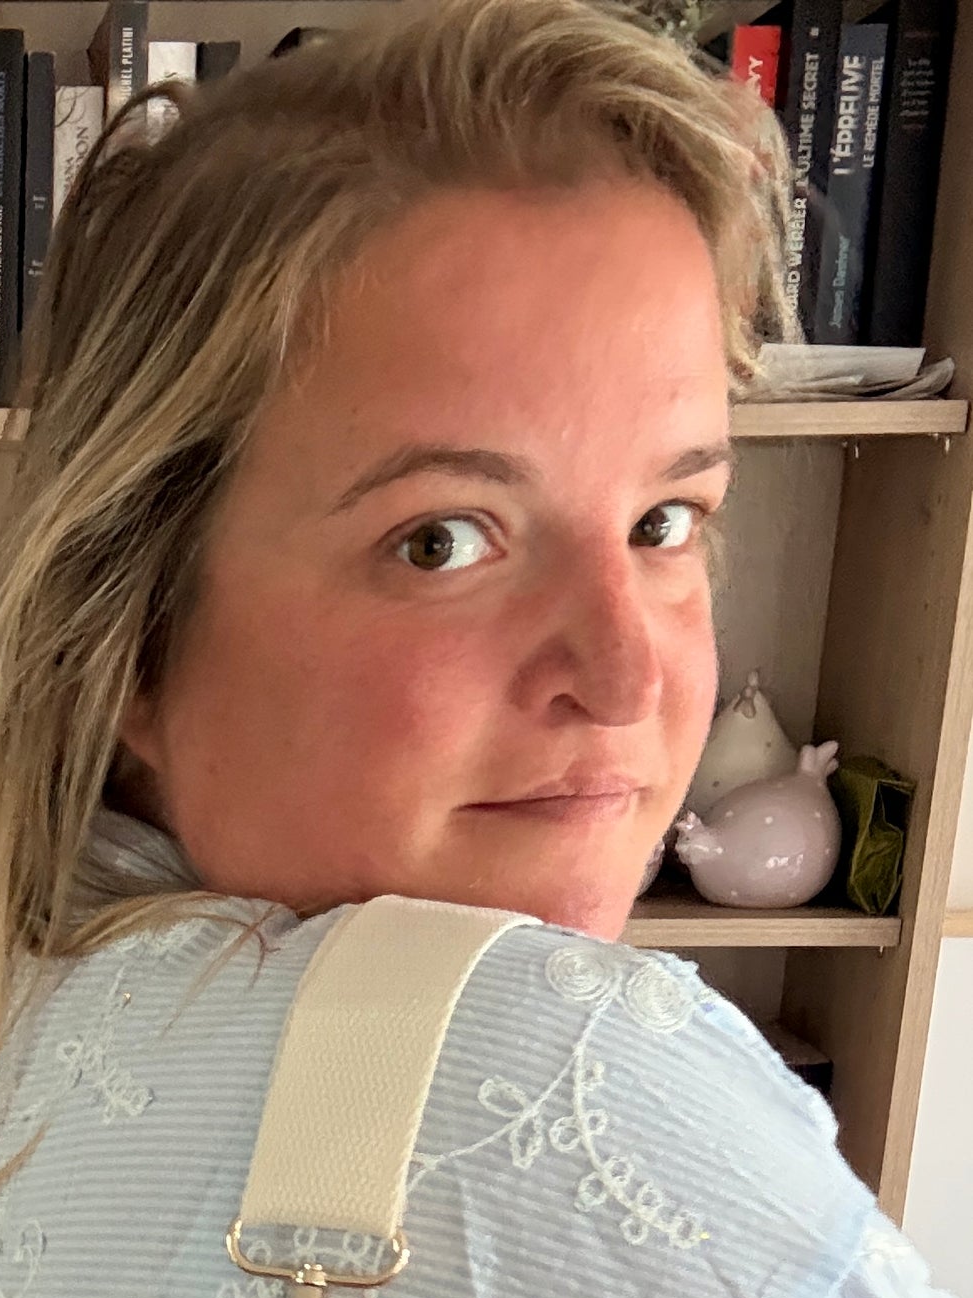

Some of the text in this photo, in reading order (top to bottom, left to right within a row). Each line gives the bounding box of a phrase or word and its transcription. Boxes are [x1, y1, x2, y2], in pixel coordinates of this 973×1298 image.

[122, 27, 134, 65] PLATINI
[802, 52, 820, 110] SECRET
[867, 56, 885, 102] MORTEL
[830, 55, 866, 175] L'ÉPREUVE
[862, 156, 875, 168] LE
